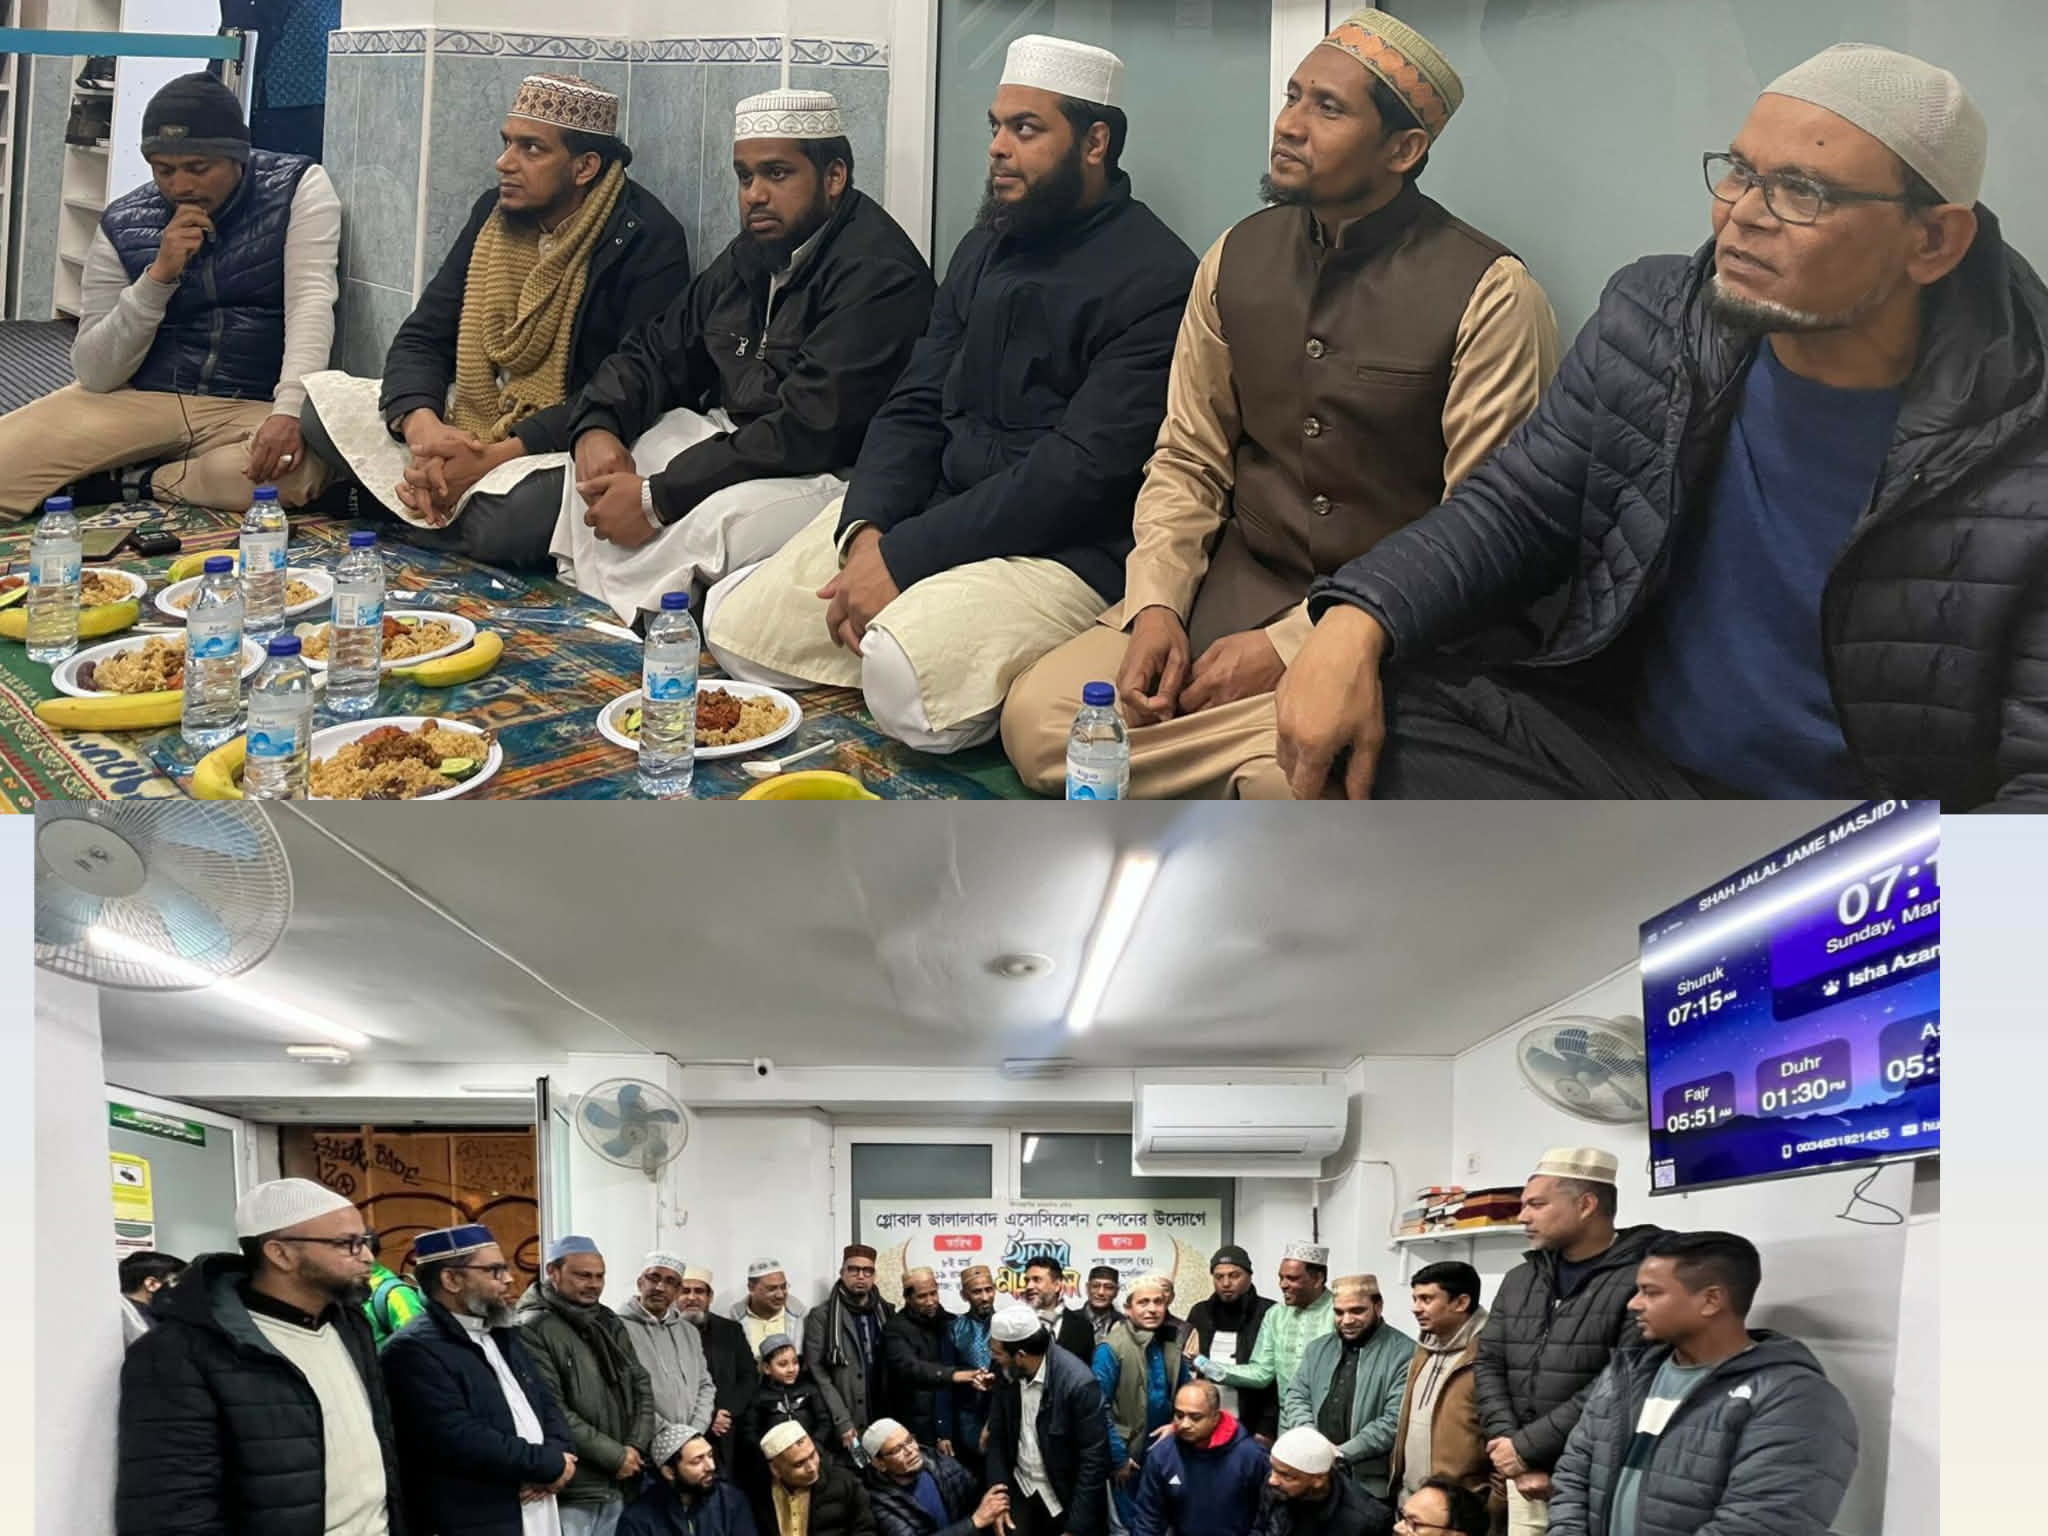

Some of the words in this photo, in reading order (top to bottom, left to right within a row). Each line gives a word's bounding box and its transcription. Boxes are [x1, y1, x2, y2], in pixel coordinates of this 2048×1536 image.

[1699, 884, 1735, 912] SHAH
[1738, 861, 1780, 892] JALAL
[1783, 836, 1826, 868] JAME
[1829, 800, 1896, 844] MASJID
[1677, 966, 1724, 996] Shuruk
[1848, 964, 1888, 988] Isha
[1781, 1056, 1822, 1077] Duhr
[1684, 1085, 1711, 1104] Fajr
[926, 1212, 998, 1228] জালালাবাদ
